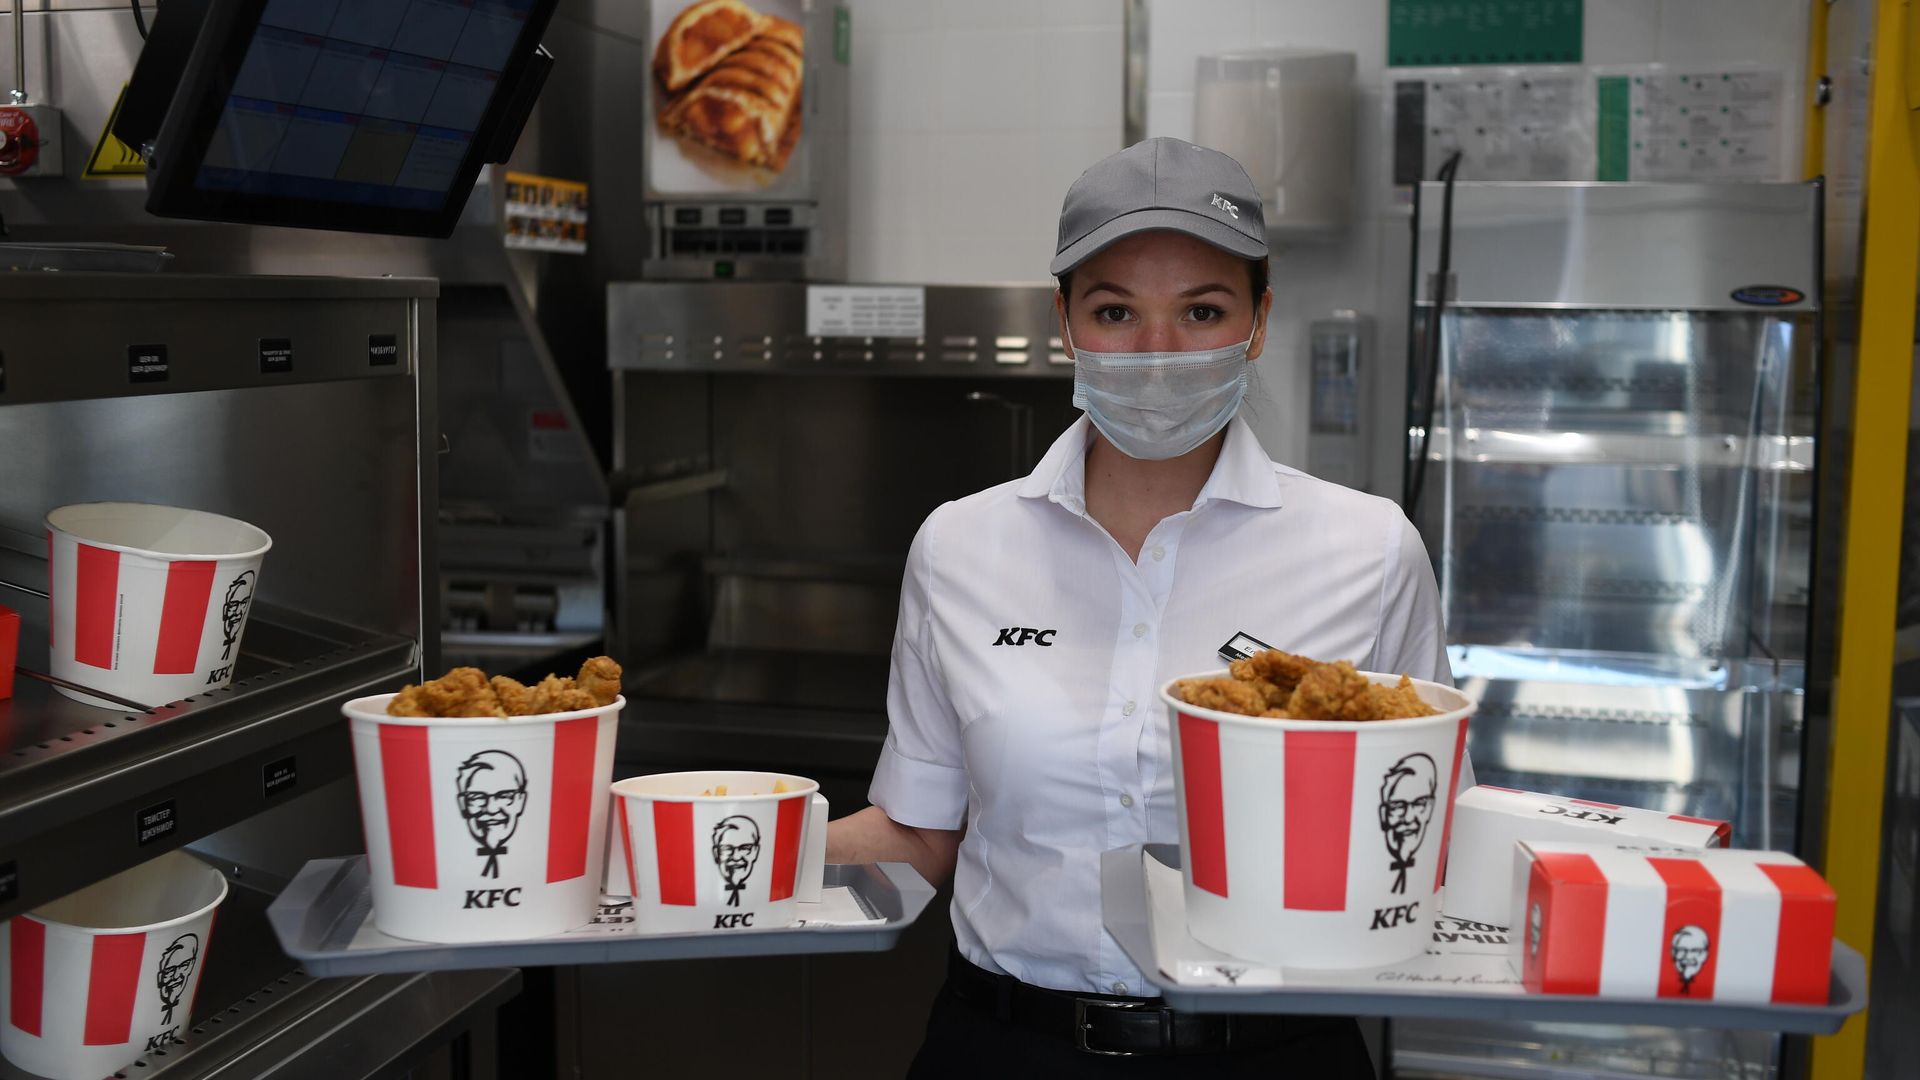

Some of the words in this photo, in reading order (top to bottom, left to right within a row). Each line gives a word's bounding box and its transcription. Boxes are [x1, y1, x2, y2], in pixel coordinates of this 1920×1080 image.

[1211, 193, 1239, 220] KFC
[992, 627, 1057, 647] KFC
[206, 664, 232, 684] KFC
[143, 808, 171, 826] ТВИСТЕР
[1539, 805, 1627, 824] KFC
[462, 887, 522, 909] KFC
[713, 912, 754, 929] KFC
[1370, 902, 1419, 930] KFC
[144, 1025, 180, 1051] KFC
